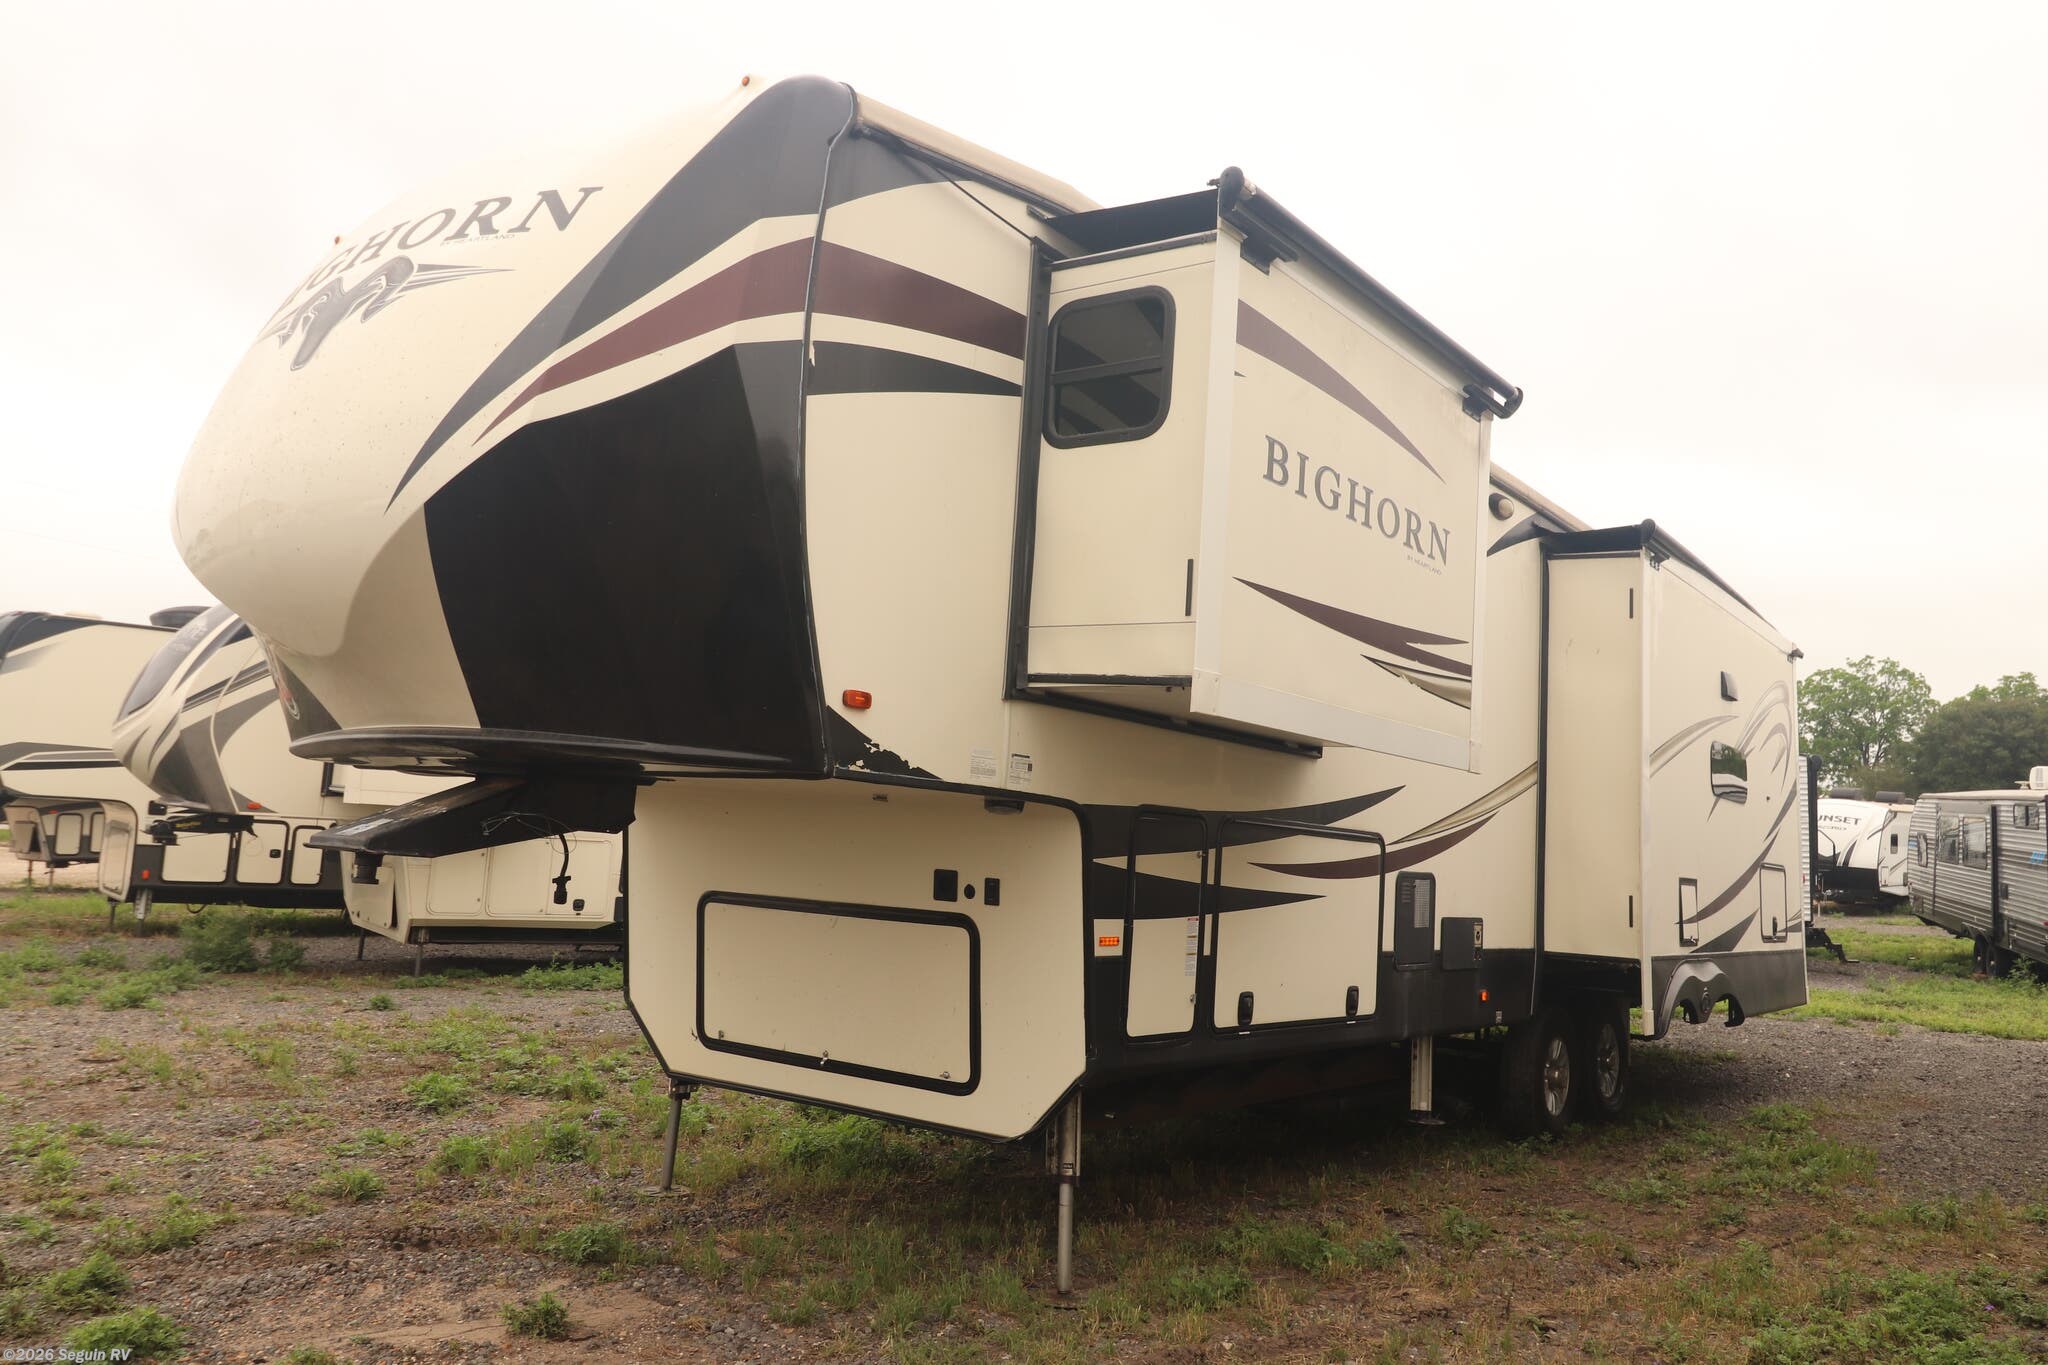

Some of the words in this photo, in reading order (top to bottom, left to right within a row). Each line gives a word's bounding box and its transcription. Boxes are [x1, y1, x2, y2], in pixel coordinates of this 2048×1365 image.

[278, 186, 604, 314] GHORN
[1263, 434, 1451, 566] BIGHORN
[1819, 815, 1862, 826] NSET
